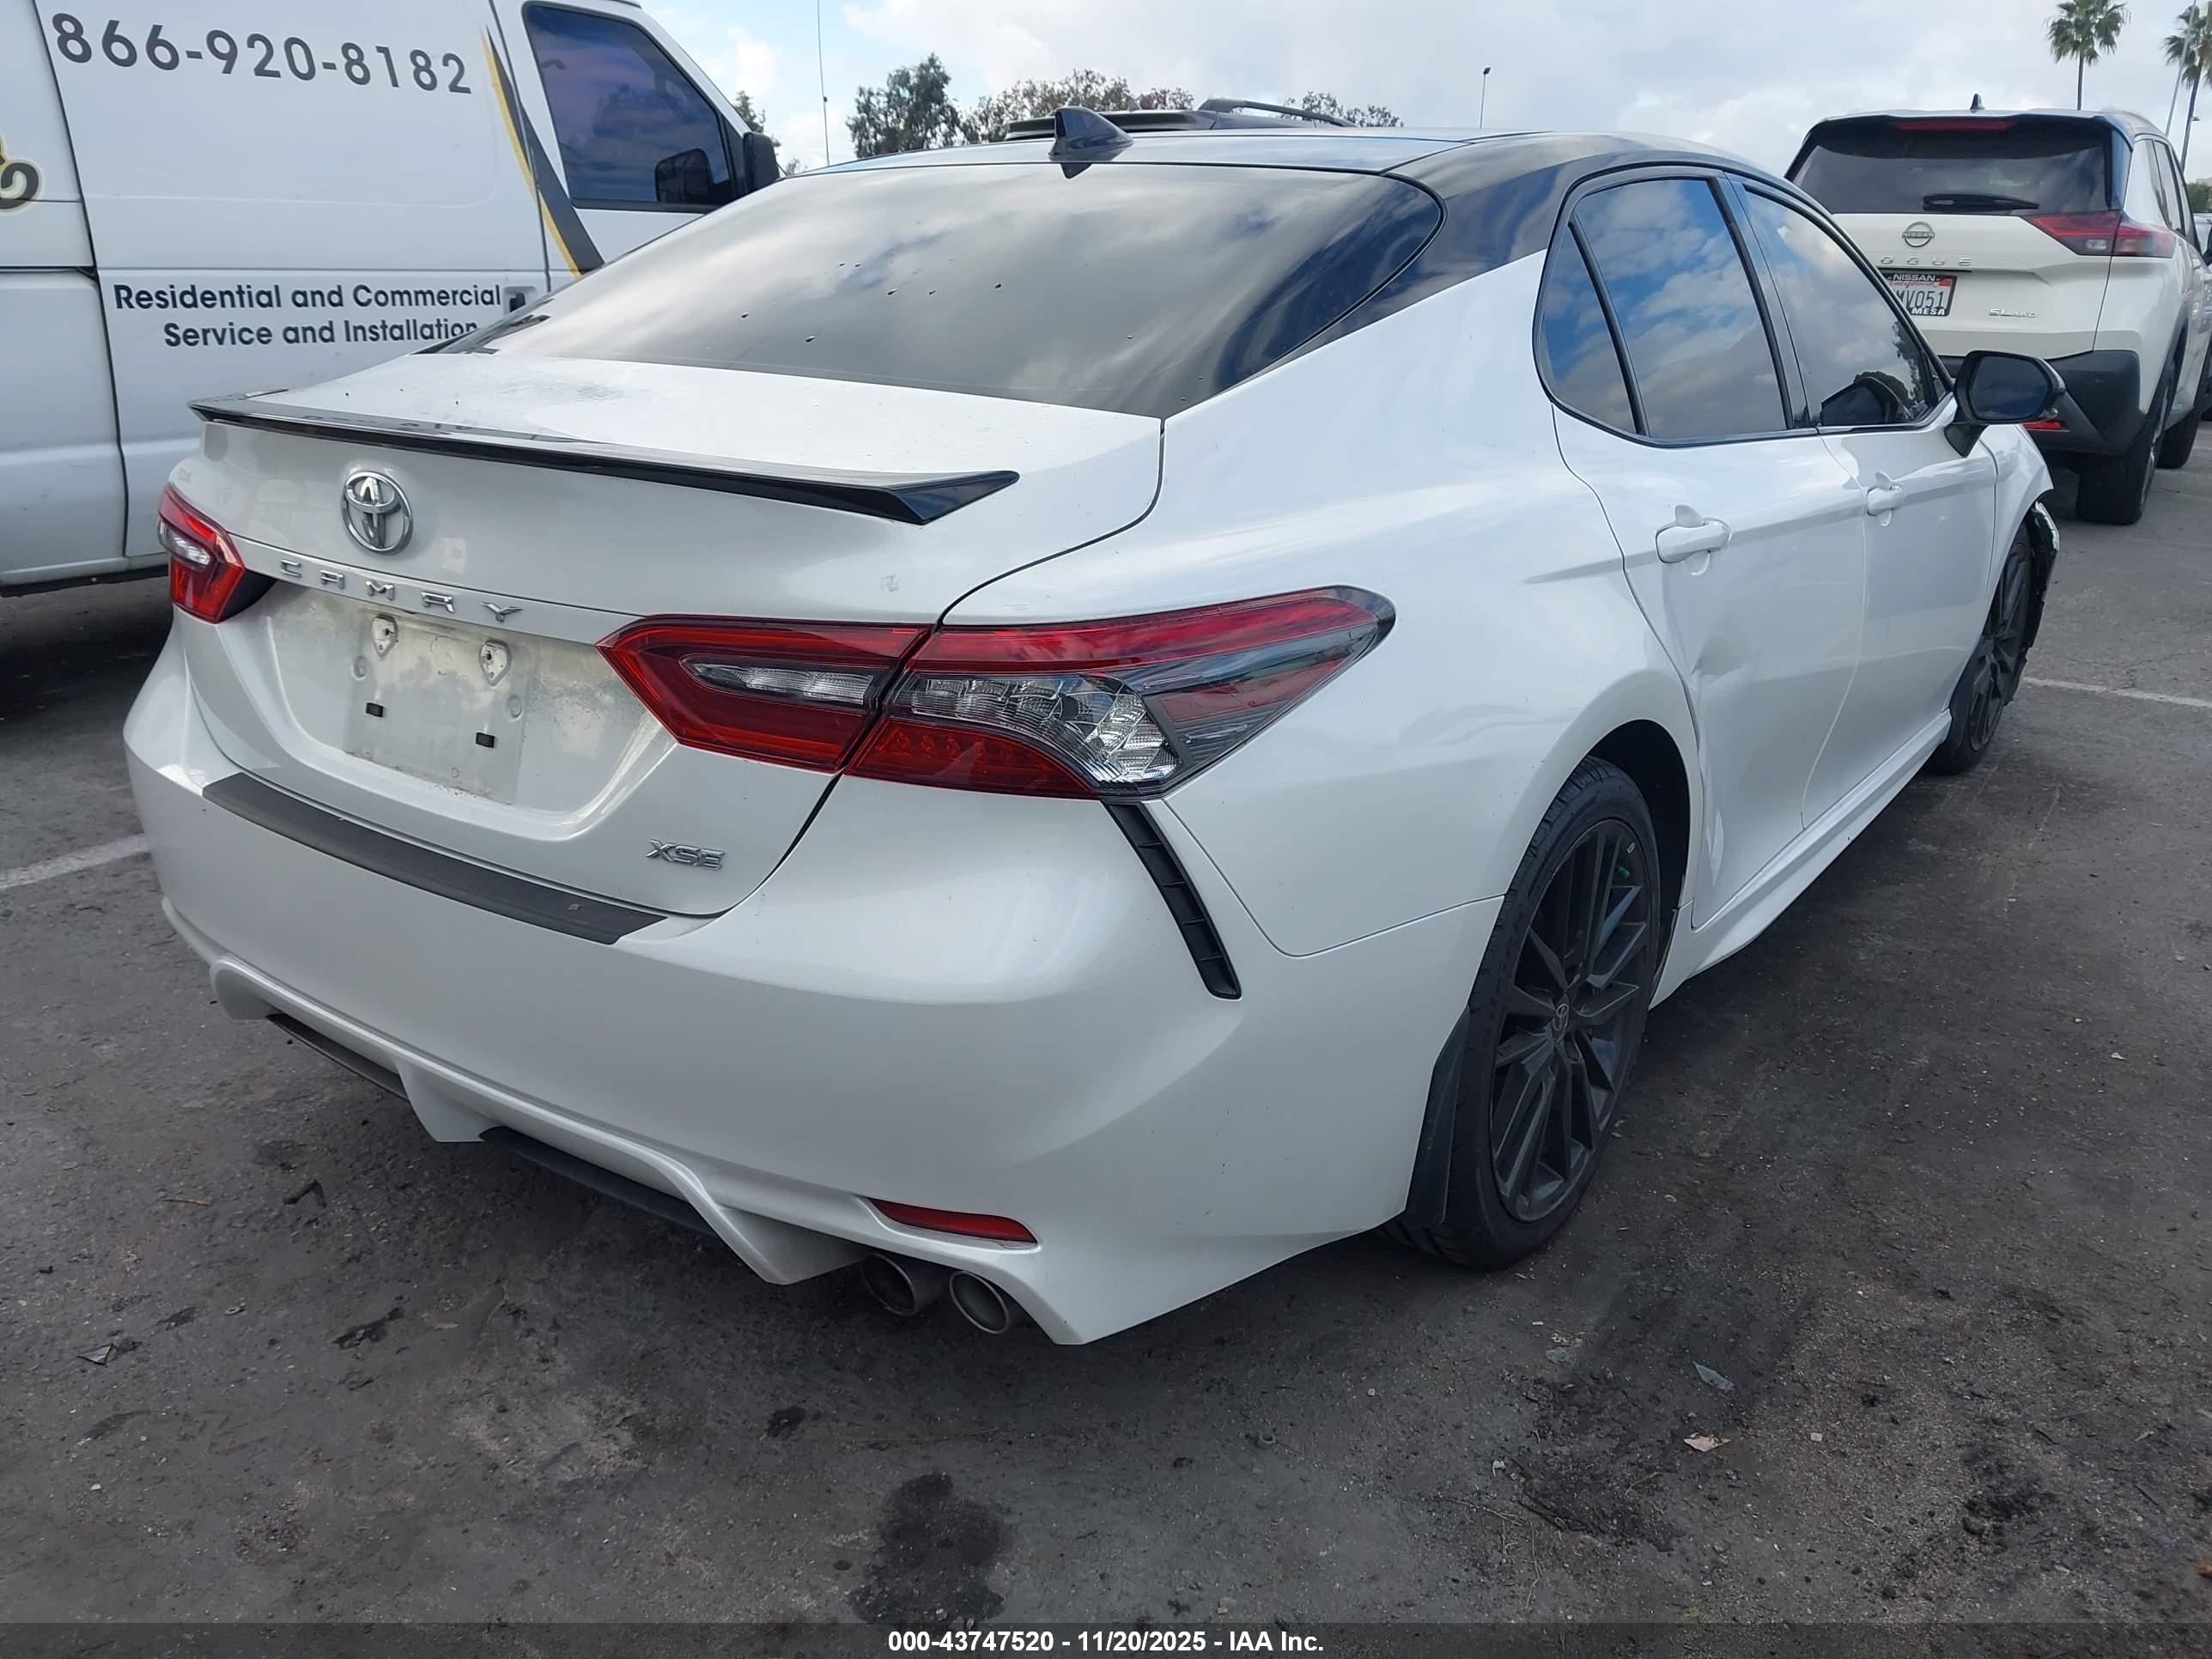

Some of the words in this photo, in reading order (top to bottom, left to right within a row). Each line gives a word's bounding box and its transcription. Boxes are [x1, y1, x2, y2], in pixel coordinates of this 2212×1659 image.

[52, 12, 471, 94] 866-920-8182
[114, 284, 282, 309] Residential
[291, 285, 344, 308] and
[352, 283, 501, 307] Commercial
[1893, 289, 1944, 309] MV051
[164, 322, 272, 348] Service
[282, 319, 335, 344] and
[279, 558, 523, 623] CAMRY
[646, 838, 725, 871] XSE
